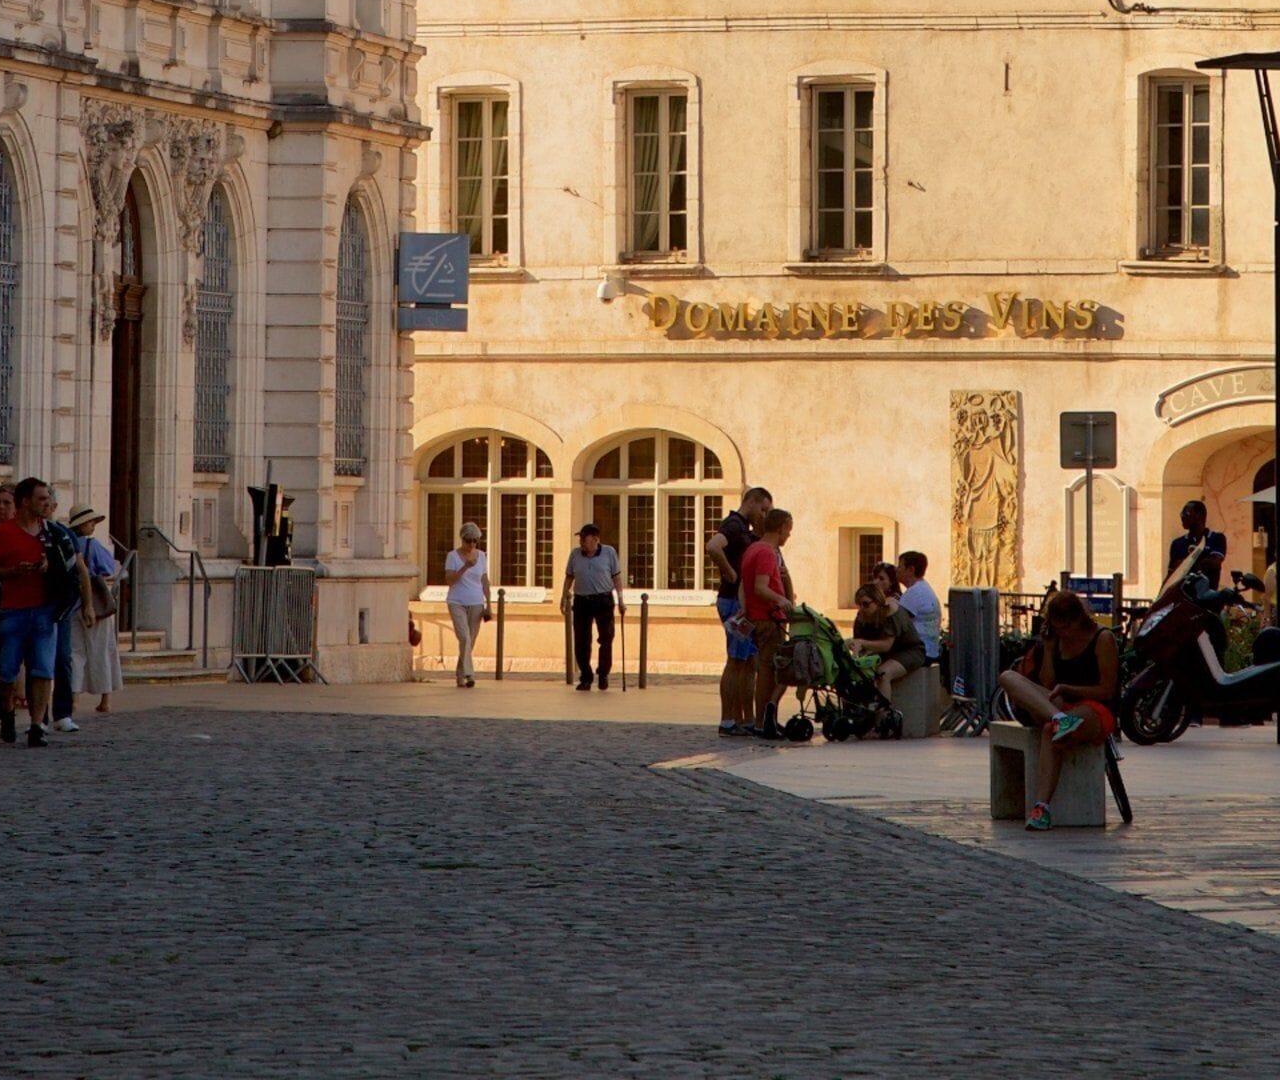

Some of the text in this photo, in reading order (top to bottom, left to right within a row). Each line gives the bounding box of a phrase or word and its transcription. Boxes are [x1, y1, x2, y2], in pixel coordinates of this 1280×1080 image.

[645, 291, 1099, 333] DOMAINE DES VINS
[1169, 373, 1248, 414] CAVE
